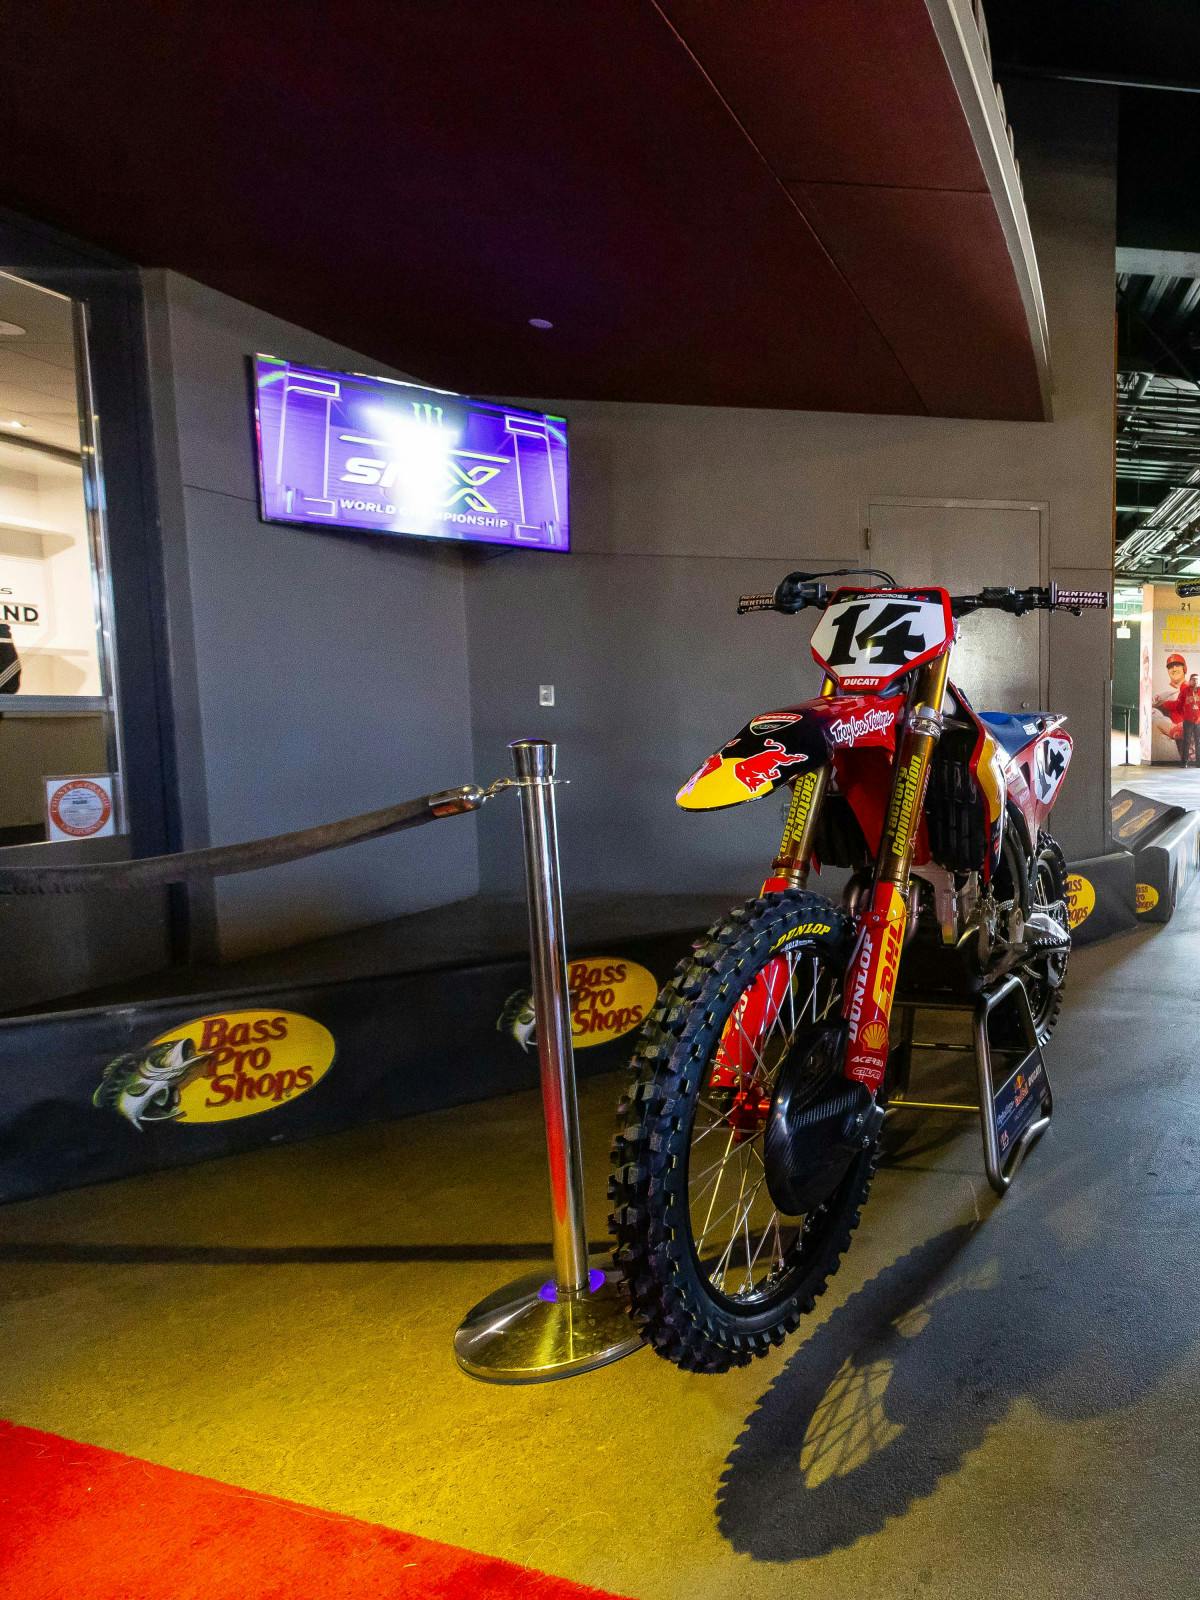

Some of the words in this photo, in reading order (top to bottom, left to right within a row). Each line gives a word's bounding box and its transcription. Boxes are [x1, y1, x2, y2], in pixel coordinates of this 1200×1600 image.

[339, 499, 397, 515] WORLD
[400, 505, 509, 529] CMPIONSHIP
[1057, 590, 1105, 598] RENTHAL
[1057, 596, 1105, 605] RENTHAL
[826, 603, 926, 665] 14
[843, 678, 880, 686] DUCATI
[791, 772, 818, 842] Factory
[891, 754, 921, 857] Connection
[1066, 879, 1083, 893] ass
[774, 923, 831, 950] DUNLOP
[568, 963, 628, 990] Bass
[848, 932, 873, 1044] DUNLOP
[572, 986, 615, 1010] Pro
[201, 1015, 288, 1052] Bass
[570, 1001, 643, 1036] Shops
[202, 1046, 272, 1080] Pro
[204, 1065, 314, 1108] Shops
